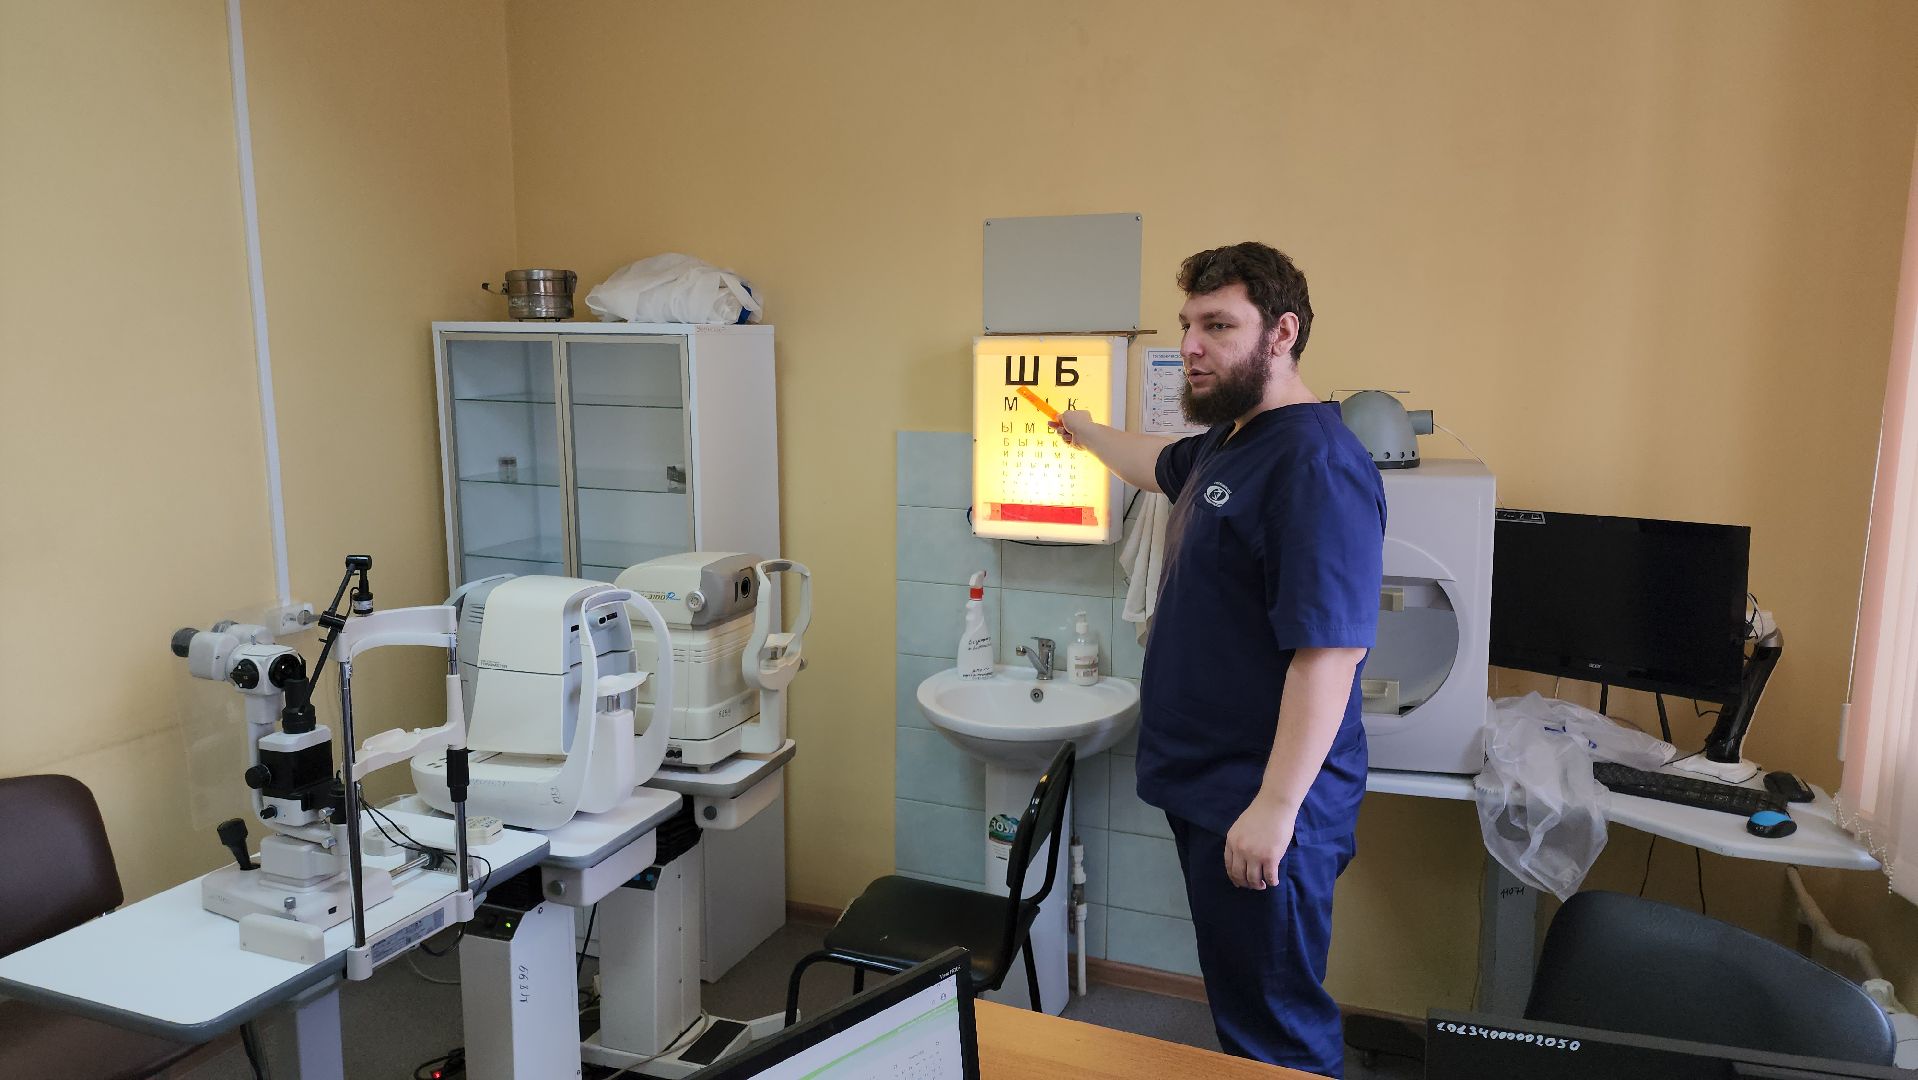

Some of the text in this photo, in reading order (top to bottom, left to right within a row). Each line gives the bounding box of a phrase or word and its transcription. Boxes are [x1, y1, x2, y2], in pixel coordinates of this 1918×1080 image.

[1005, 355, 1079, 387] Ш Б
[1004, 396, 1018, 411] М
[1001, 421, 1013, 434] Ы
[1025, 422, 1035, 434] М
[1003, 437, 1010, 447] Б
[1018, 438, 1028, 447] Ы
